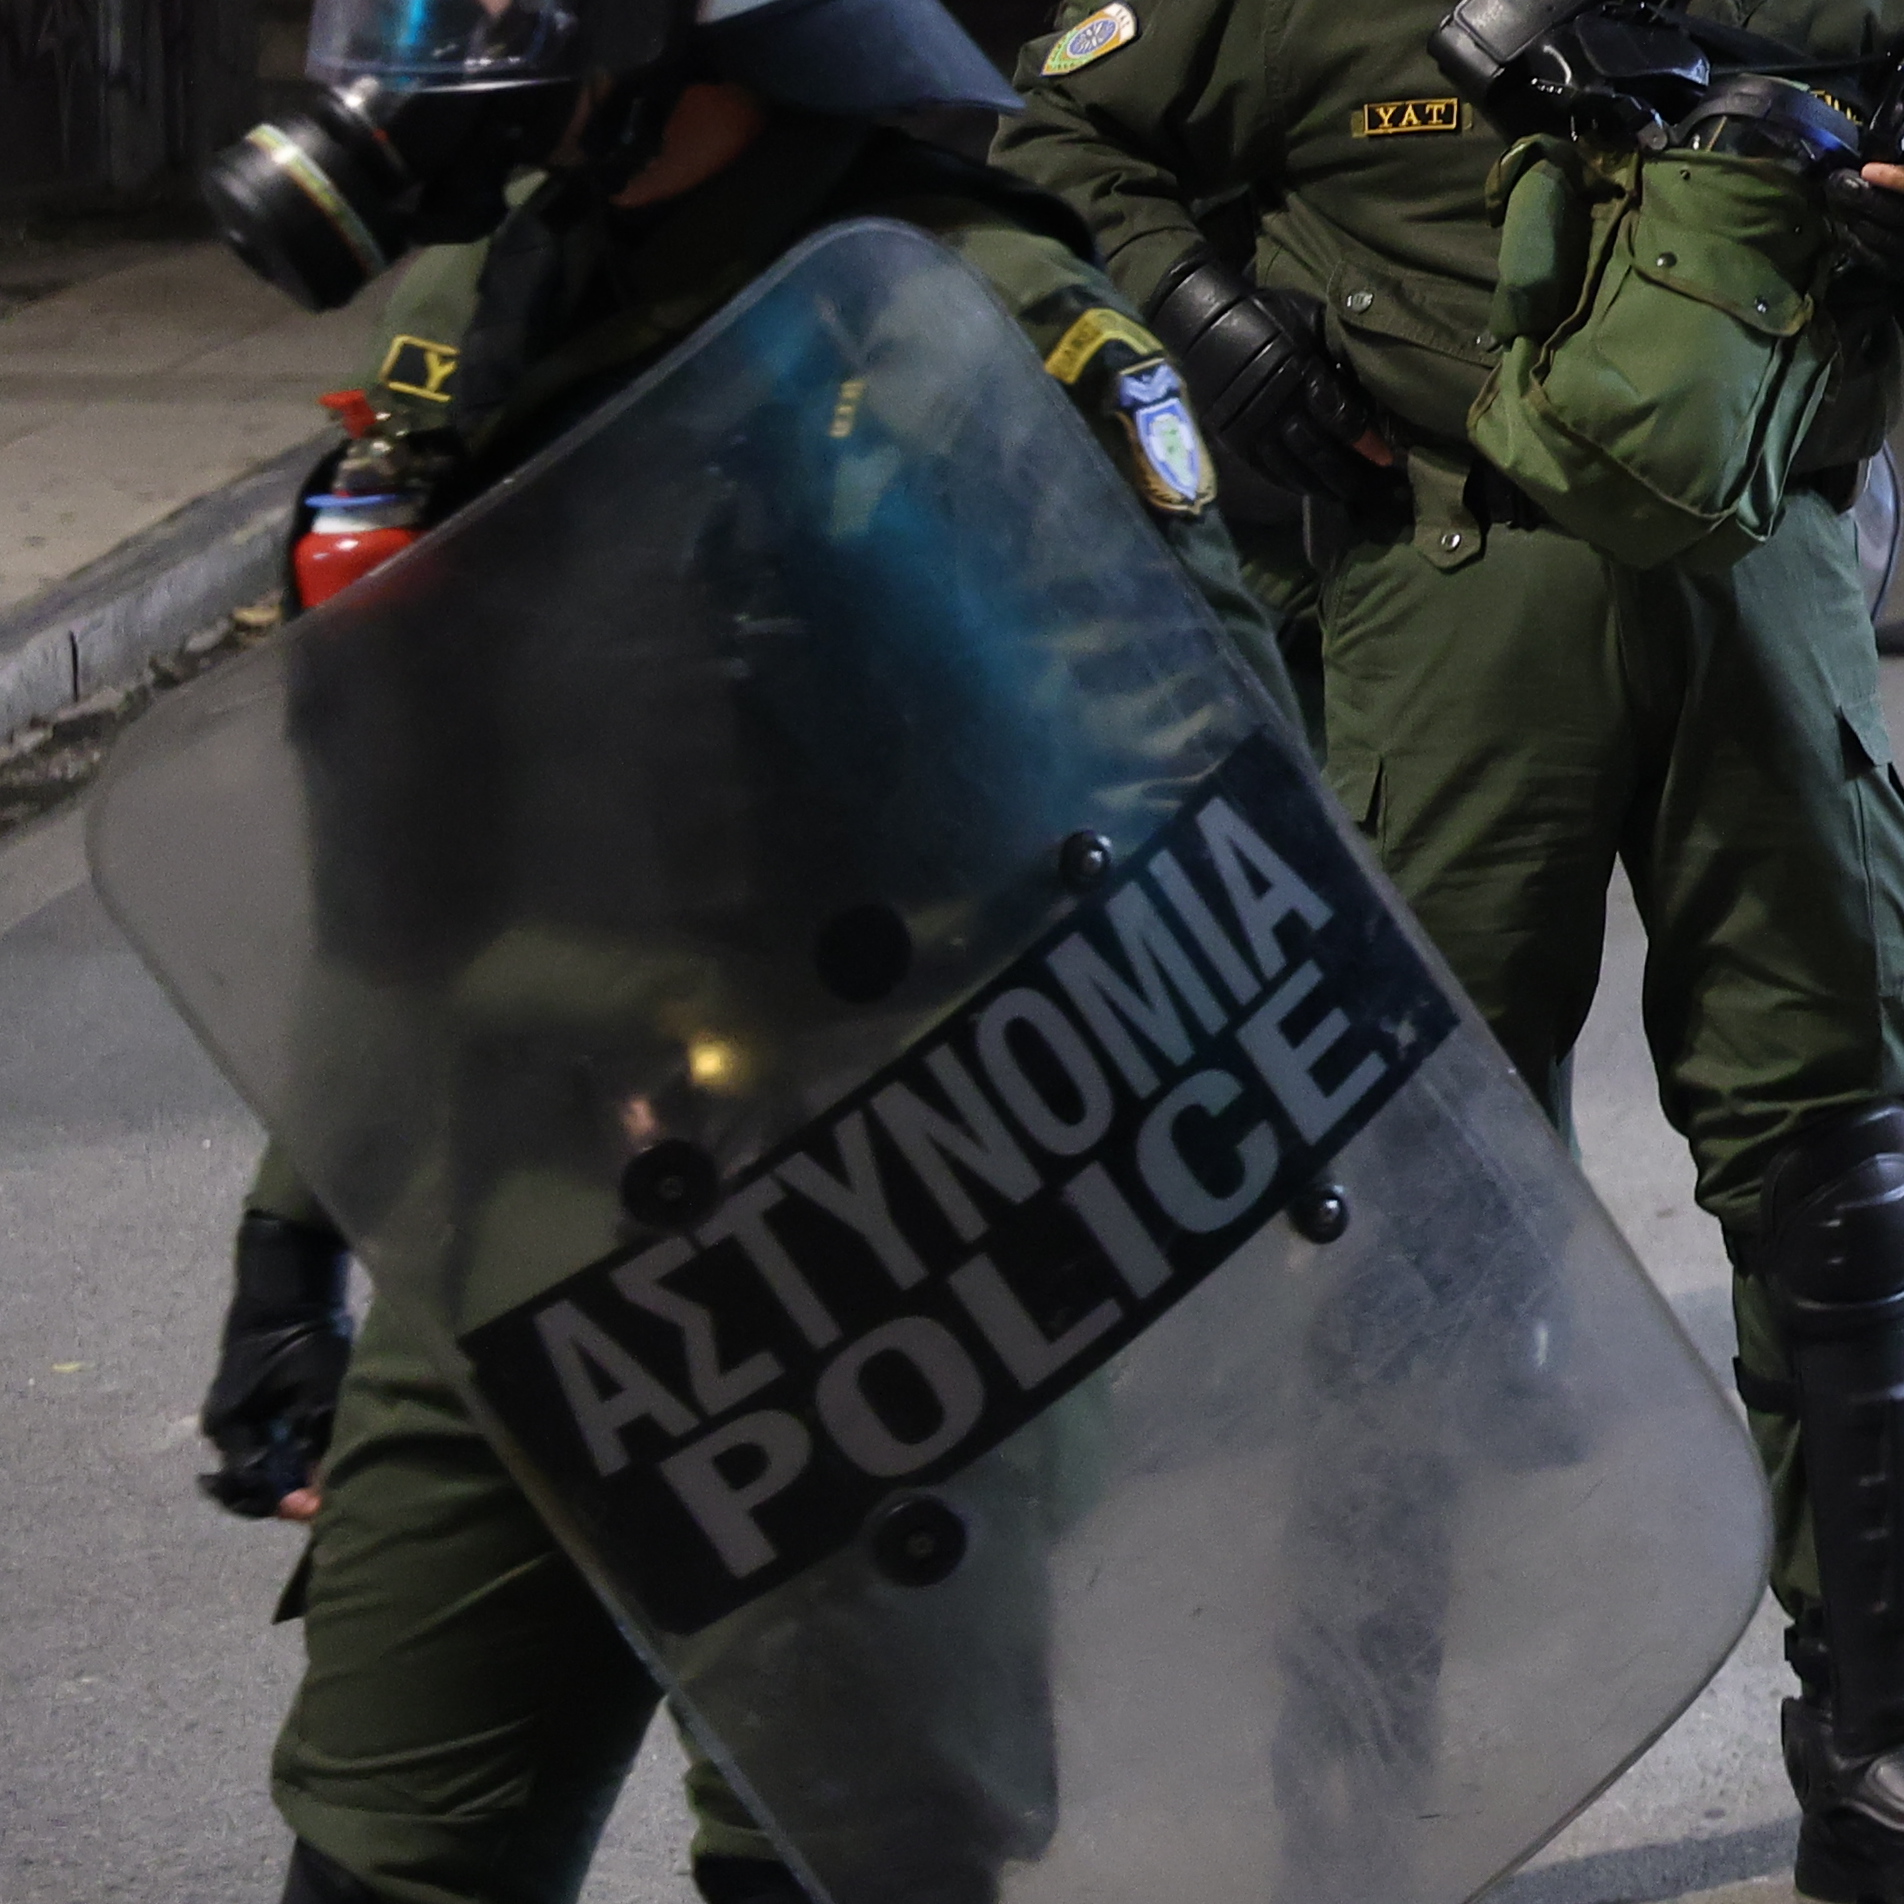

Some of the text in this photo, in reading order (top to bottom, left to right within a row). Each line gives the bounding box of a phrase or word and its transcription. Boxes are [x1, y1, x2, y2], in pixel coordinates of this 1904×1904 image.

[1375, 103, 1446, 128] ΥΑΤ
[531, 794, 1336, 1480] ΑΣΤΥΝΟΜΙΑ
[659, 958, 1387, 1582] POLICE
